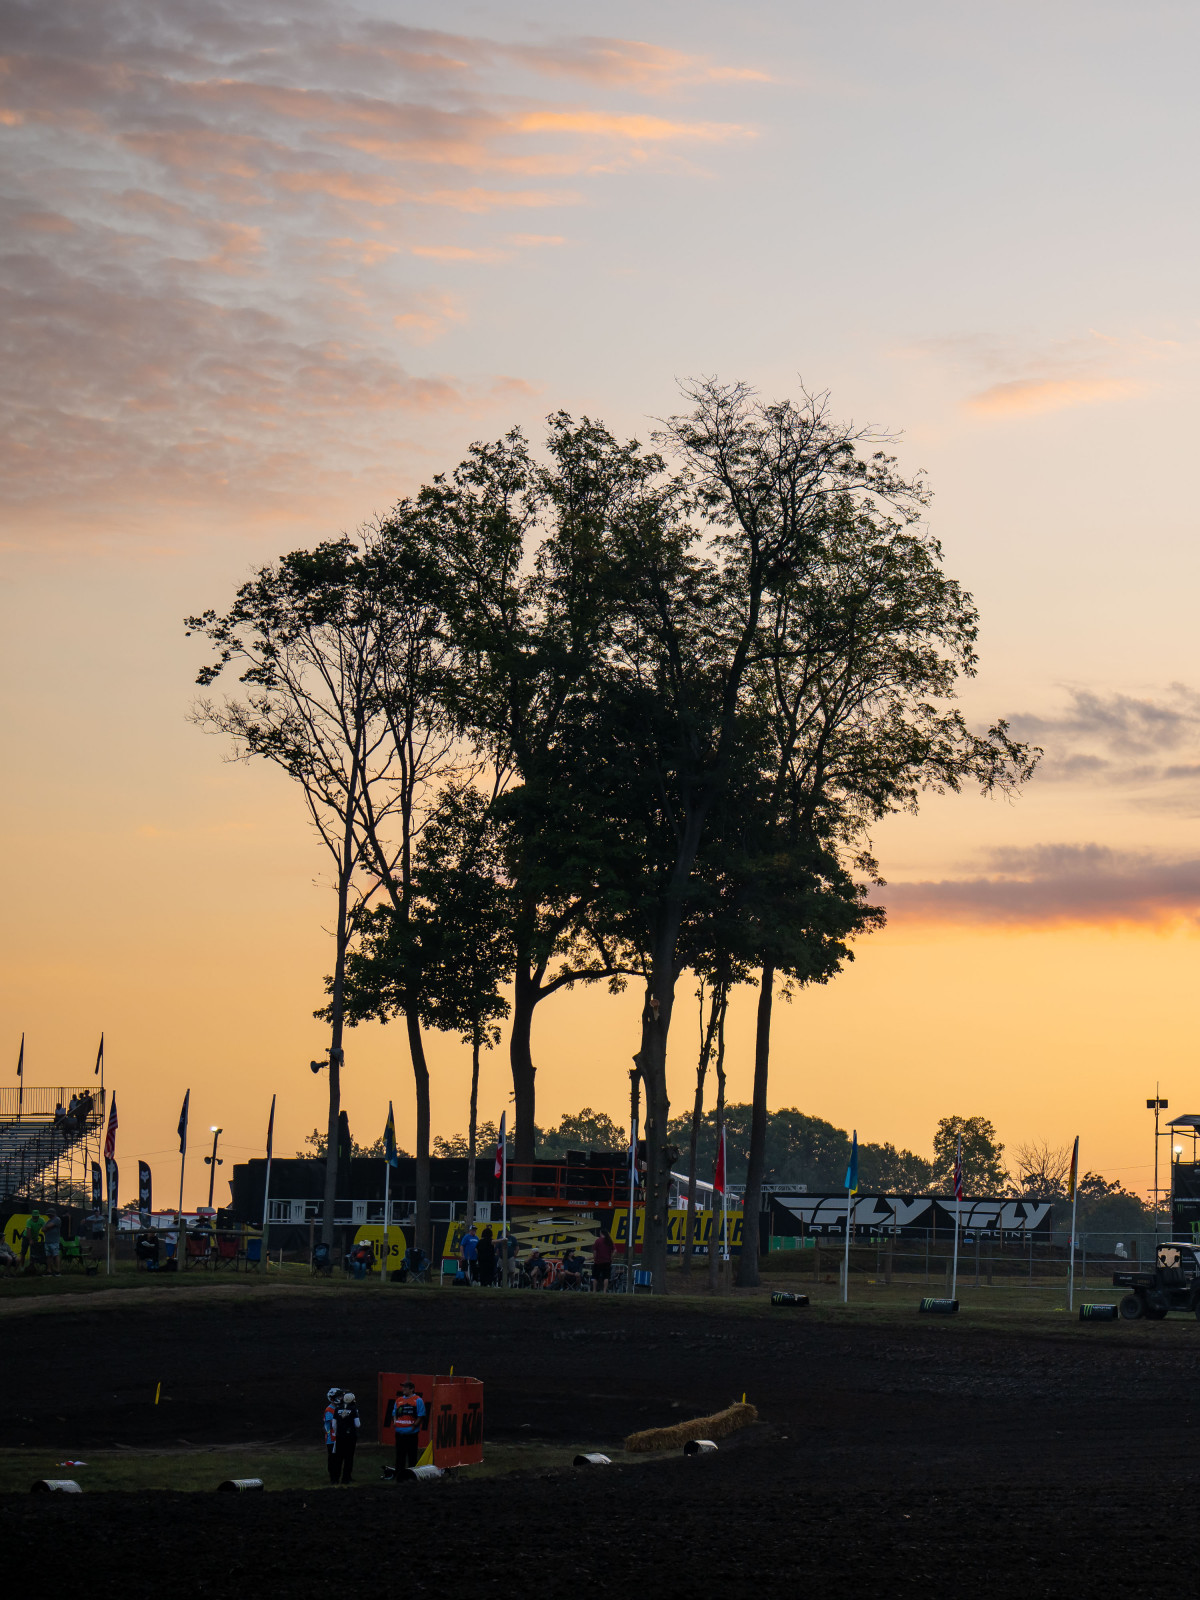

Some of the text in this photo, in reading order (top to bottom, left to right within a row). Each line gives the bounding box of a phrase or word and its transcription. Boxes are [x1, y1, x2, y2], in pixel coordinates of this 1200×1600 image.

[809, 1225, 902, 1234] RACING
[437, 1404, 457, 1449] KTM
[461, 1403, 483, 1446] KTM
